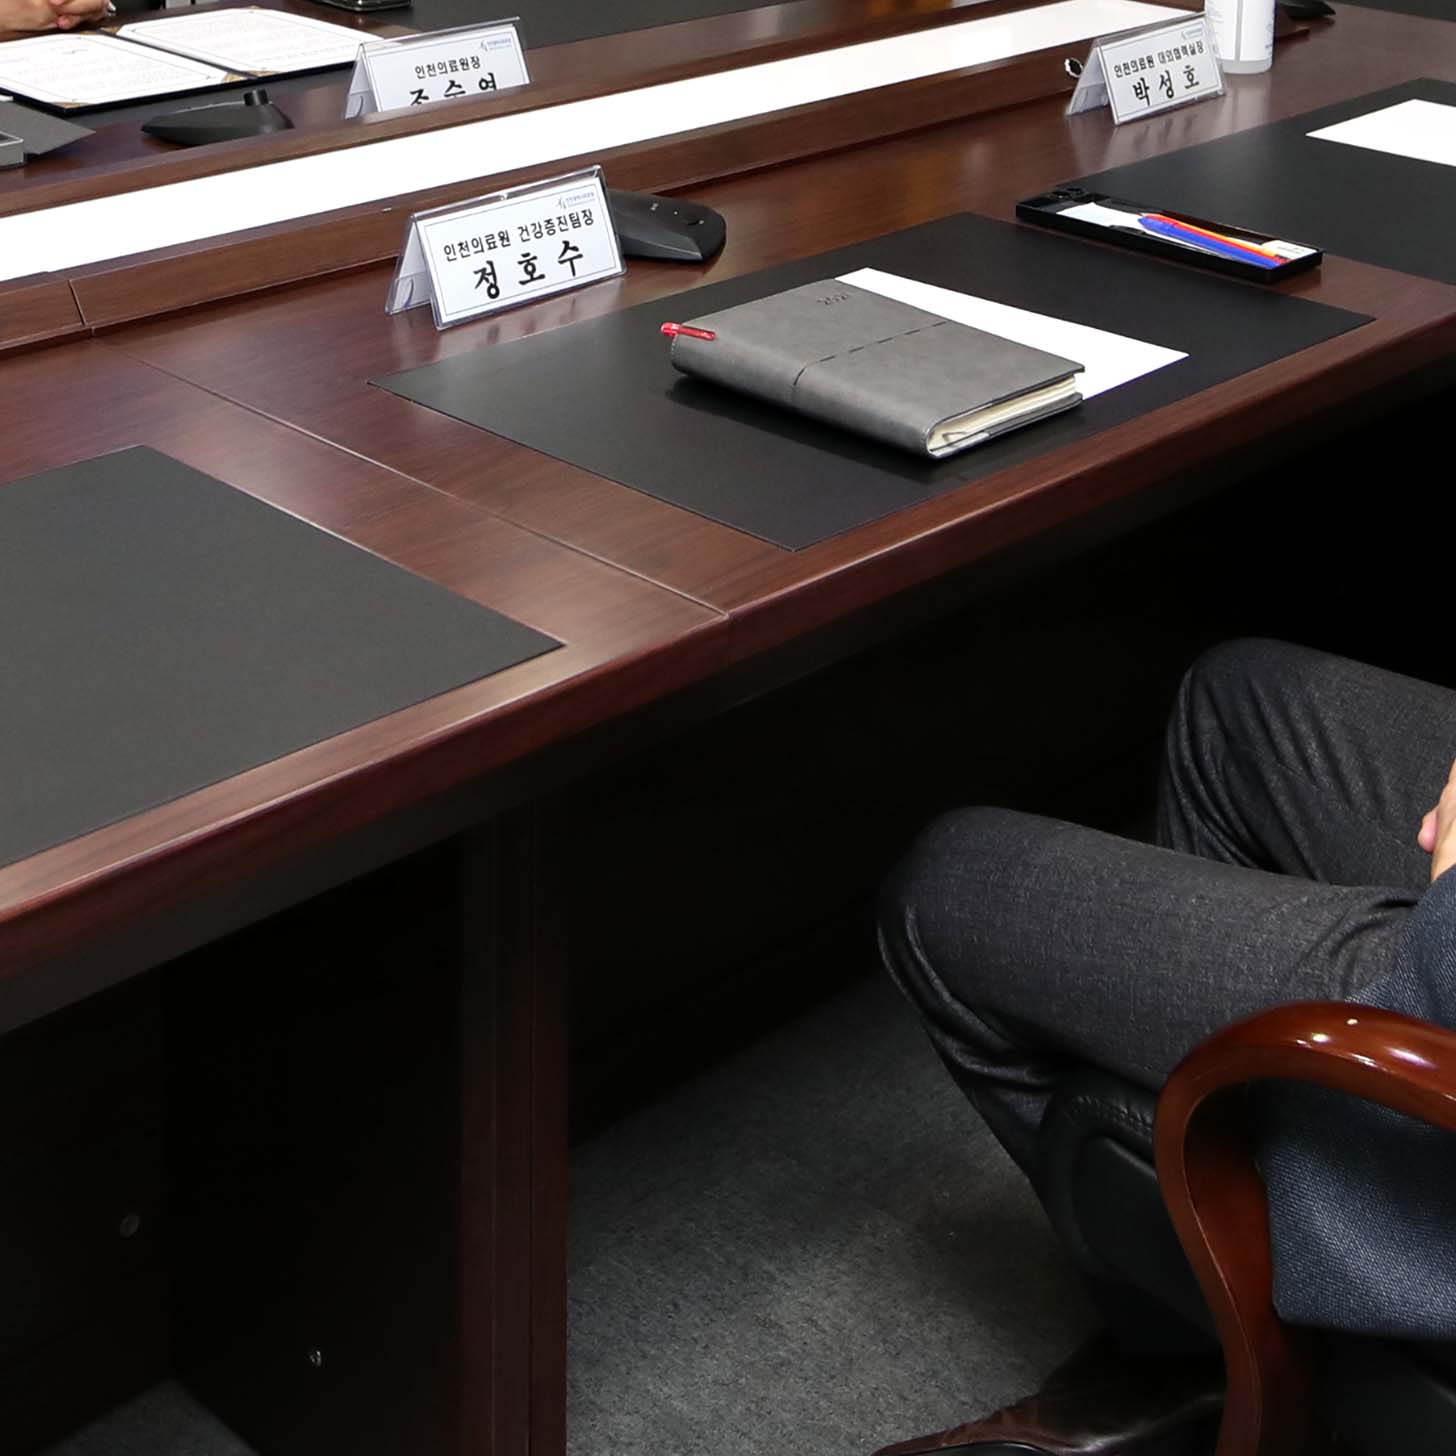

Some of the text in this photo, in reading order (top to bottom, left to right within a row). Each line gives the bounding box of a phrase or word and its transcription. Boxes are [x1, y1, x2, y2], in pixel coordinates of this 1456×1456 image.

[414, 55, 481, 79] 인천의료원장
[1113, 55, 1155, 79] 인천의료원
[1132, 64, 1200, 106] 박성호
[443, 208, 595, 262] 인천의료원 건강증진팀장
[472, 239, 584, 300] 정호수
